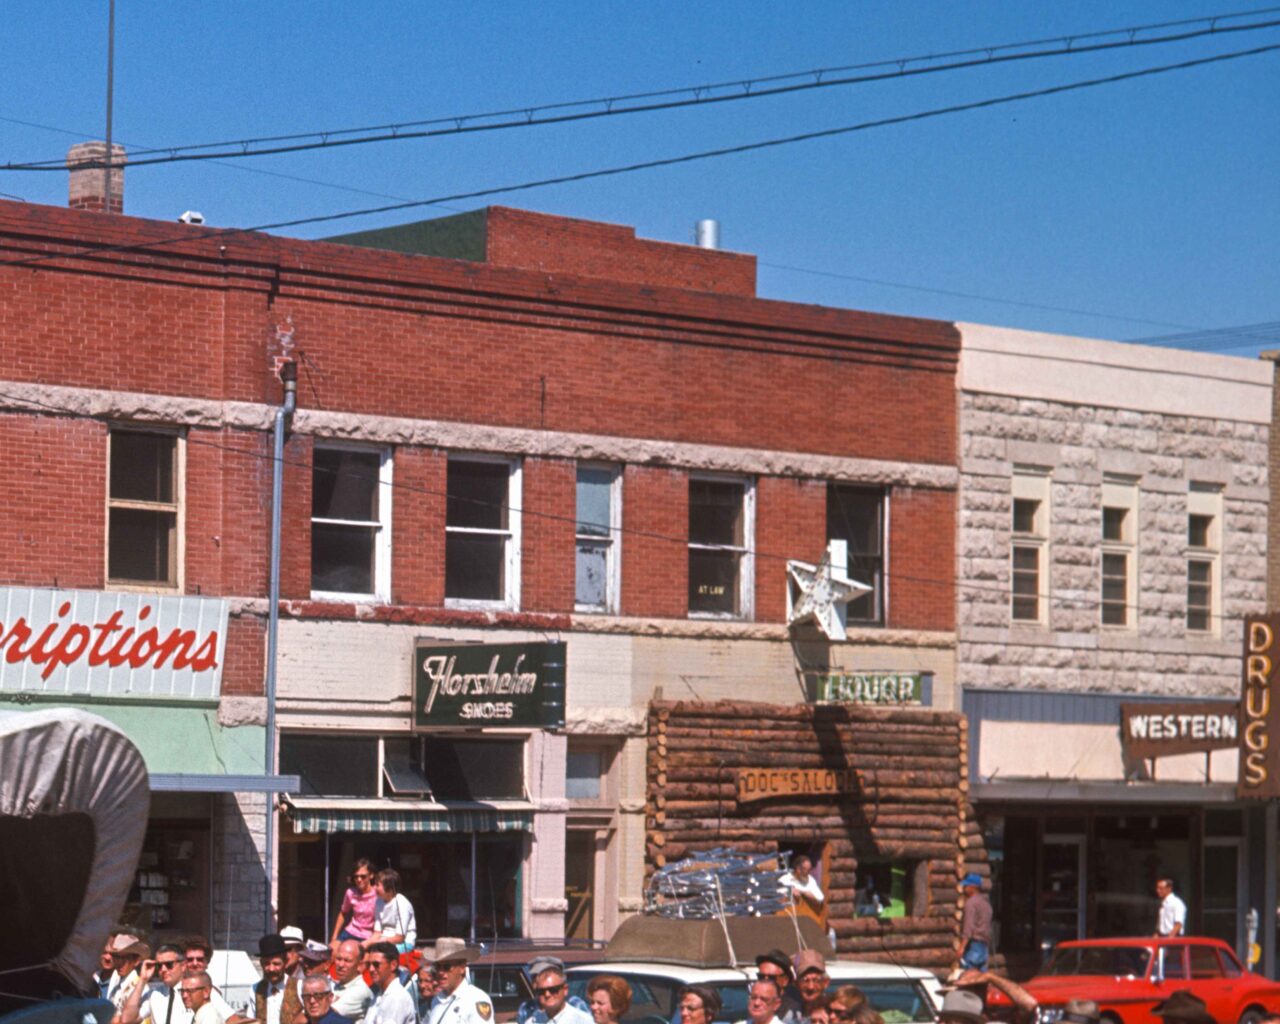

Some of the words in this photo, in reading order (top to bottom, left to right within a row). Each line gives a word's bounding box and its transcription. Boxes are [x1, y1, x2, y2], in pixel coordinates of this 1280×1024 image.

[423, 654, 537, 714] Florsheim
[1245, 622, 1273, 784] DRUGS
[460, 701, 513, 719] SHOES
[1129, 715, 1237, 738] WESTERN
